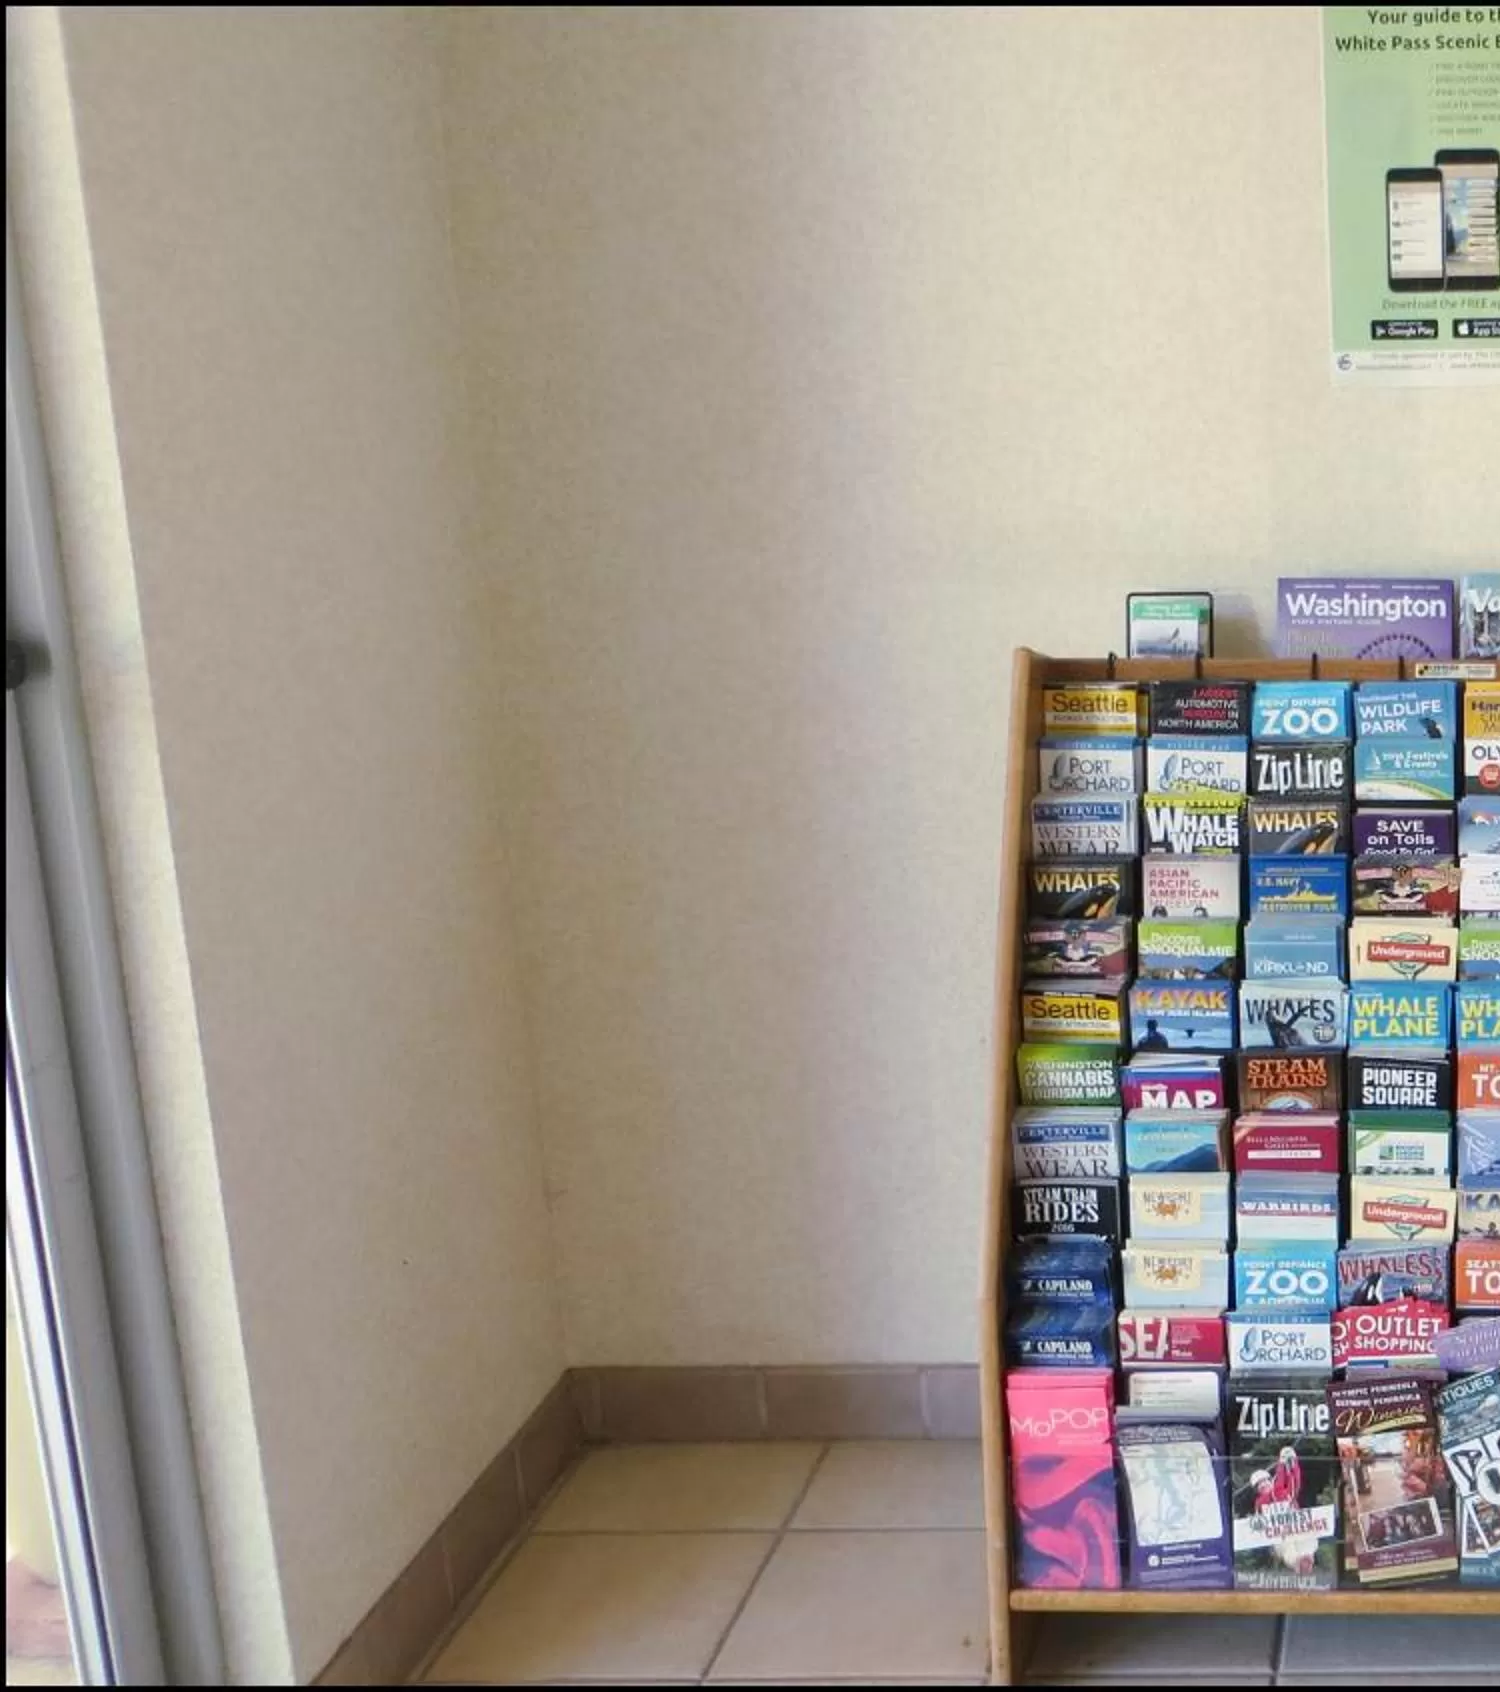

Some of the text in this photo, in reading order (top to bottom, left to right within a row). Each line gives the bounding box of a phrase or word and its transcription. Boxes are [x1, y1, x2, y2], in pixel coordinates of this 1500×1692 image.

[1368, 9, 1407, 25] Your
[1413, 9, 1461, 26] guide
[1466, 9, 1484, 23] to
[1336, 36, 1387, 52] White
[1391, 36, 1431, 50] Pass
[1436, 34, 1489, 49] Scenic
[1460, 299, 1488, 309] FREE
[1388, 326, 1435, 337] Google Play
[1474, 326, 1490, 337] App
[1286, 592, 1446, 622] Washington
[1052, 693, 1128, 713] Seattle
[1359, 700, 1443, 718] WILDLIFE
[1228, 709, 1238, 719] IN
[1261, 708, 1338, 735] ZOO
[1157, 719, 1238, 729] NORTH AMERICA
[1361, 719, 1408, 734] PARK
[1069, 757, 1112, 775] PORT
[1181, 757, 1225, 775] PORT
[1254, 753, 1344, 795] Zip Line
[1035, 803, 1121, 815] CENTERVILLE
[1146, 807, 1238, 843] WHALE
[1253, 811, 1339, 834] WHALES
[1377, 820, 1425, 832] SAVE
[1038, 826, 1121, 839] WESTERN
[1367, 833, 1435, 845] on Tolls
[1039, 840, 1120, 857] WEAR
[1171, 831, 1239, 854] WATCH
[1150, 869, 1190, 878] ASIAN
[1035, 872, 1121, 893] WHALES
[1150, 880, 1201, 888] PACIFIC
[1150, 889, 1219, 898] AMERICAN
[1139, 945, 1236, 957] SNOQUALMIE
[1370, 944, 1445, 959] Underground
[1135, 991, 1227, 1009] KAYAK
[1353, 997, 1440, 1017] WHALE
[1030, 999, 1110, 1019] Seattle
[1245, 999, 1335, 1025] WHALES
[1353, 1017, 1440, 1038] PLANE
[1026, 1060, 1113, 1070] WASHINGTON
[1248, 1059, 1325, 1075] STEAM
[1480, 1064, 1497, 1073] MT.
[1024, 1070, 1114, 1087] CANNABIS
[1248, 1074, 1327, 1089] TRAINS
[1362, 1068, 1437, 1088] PIONEER
[1026, 1086, 1116, 1099] TOURISM MAP
[1141, 1089, 1217, 1109] MAP
[1362, 1087, 1437, 1106] SQUARE
[1019, 1127, 1106, 1137] CENTERVILLE
[1023, 1145, 1110, 1157] WESTERN
[1025, 1159, 1109, 1178] WEAR
[1024, 1188, 1098, 1201] STEAM TRAIN
[1024, 1202, 1100, 1223] RIDES
[1366, 1205, 1444, 1222] Underground
[1339, 1253, 1432, 1285] WHALES
[1038, 1280, 1093, 1291] CAPILANO
[1245, 1269, 1329, 1295] ZOO
[1356, 1315, 1442, 1336] OUTLET
[1261, 1330, 1307, 1346] PORT
[1037, 1342, 1092, 1353] CAPILANO
[1240, 1348, 1327, 1362] ORCHARD
[1010, 1408, 1108, 1437] MoPOP
[1236, 1397, 1329, 1438] Zip Line
